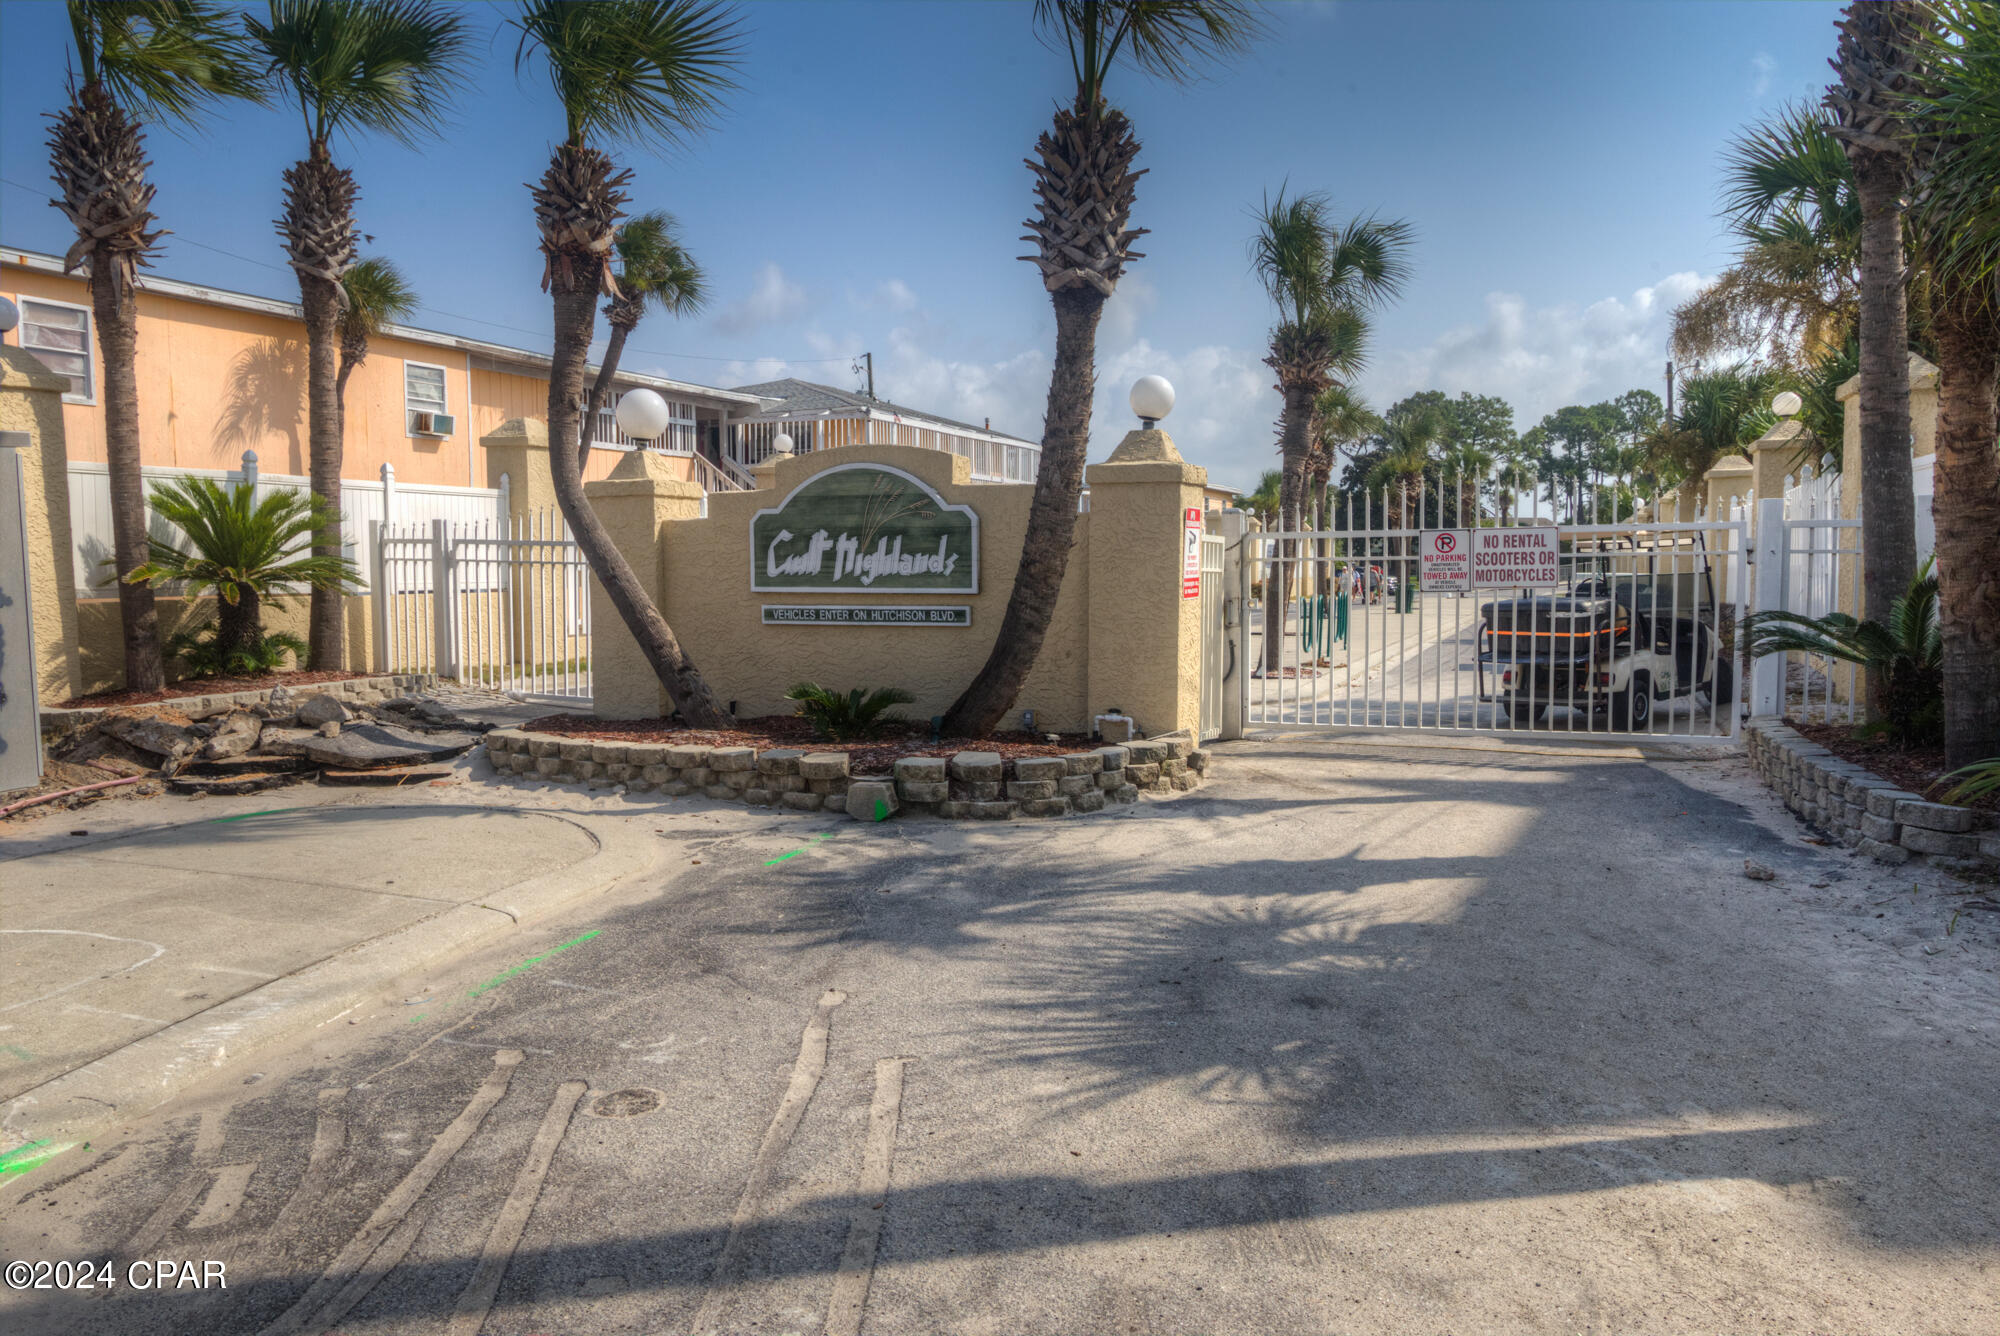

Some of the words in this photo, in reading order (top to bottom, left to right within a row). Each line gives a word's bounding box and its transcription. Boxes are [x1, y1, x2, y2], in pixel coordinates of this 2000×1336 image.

[1483, 534, 1499, 549] NO
[1503, 533, 1547, 549] RENTAL
[833, 531, 960, 586] Highlands
[1423, 554, 1434, 562] NO
[1435, 553, 1467, 562] PARKING
[1475, 551, 1535, 567] SCOOTERS
[1538, 551, 1555, 565] OR
[1423, 572, 1448, 580] TOWED
[1449, 571, 1468, 580] AWAY
[1475, 568, 1556, 583] MOTORCYCLES
[772, 609, 816, 621] VEHICLES
[819, 609, 849, 621] ENTER
[853, 610, 868, 621] ON
[871, 610, 926, 621] HUTCHISON
[930, 611, 957, 622] BLVD.
